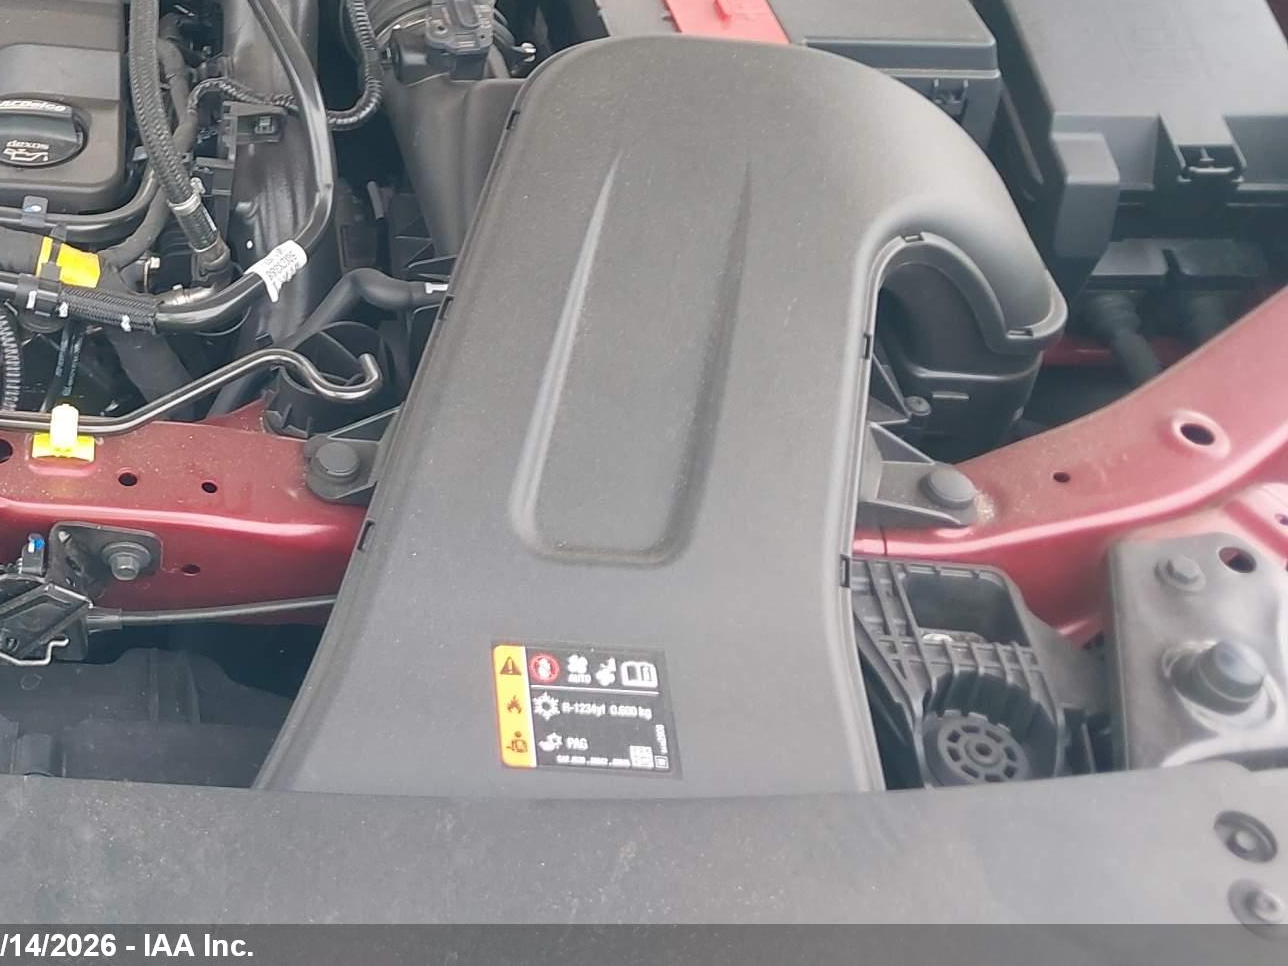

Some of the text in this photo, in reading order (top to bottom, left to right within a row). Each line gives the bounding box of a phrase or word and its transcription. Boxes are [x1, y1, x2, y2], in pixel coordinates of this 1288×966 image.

[7, 140, 49, 149] dexos
[638, 706, 652, 720] kg
[567, 737, 588, 750] PAG
